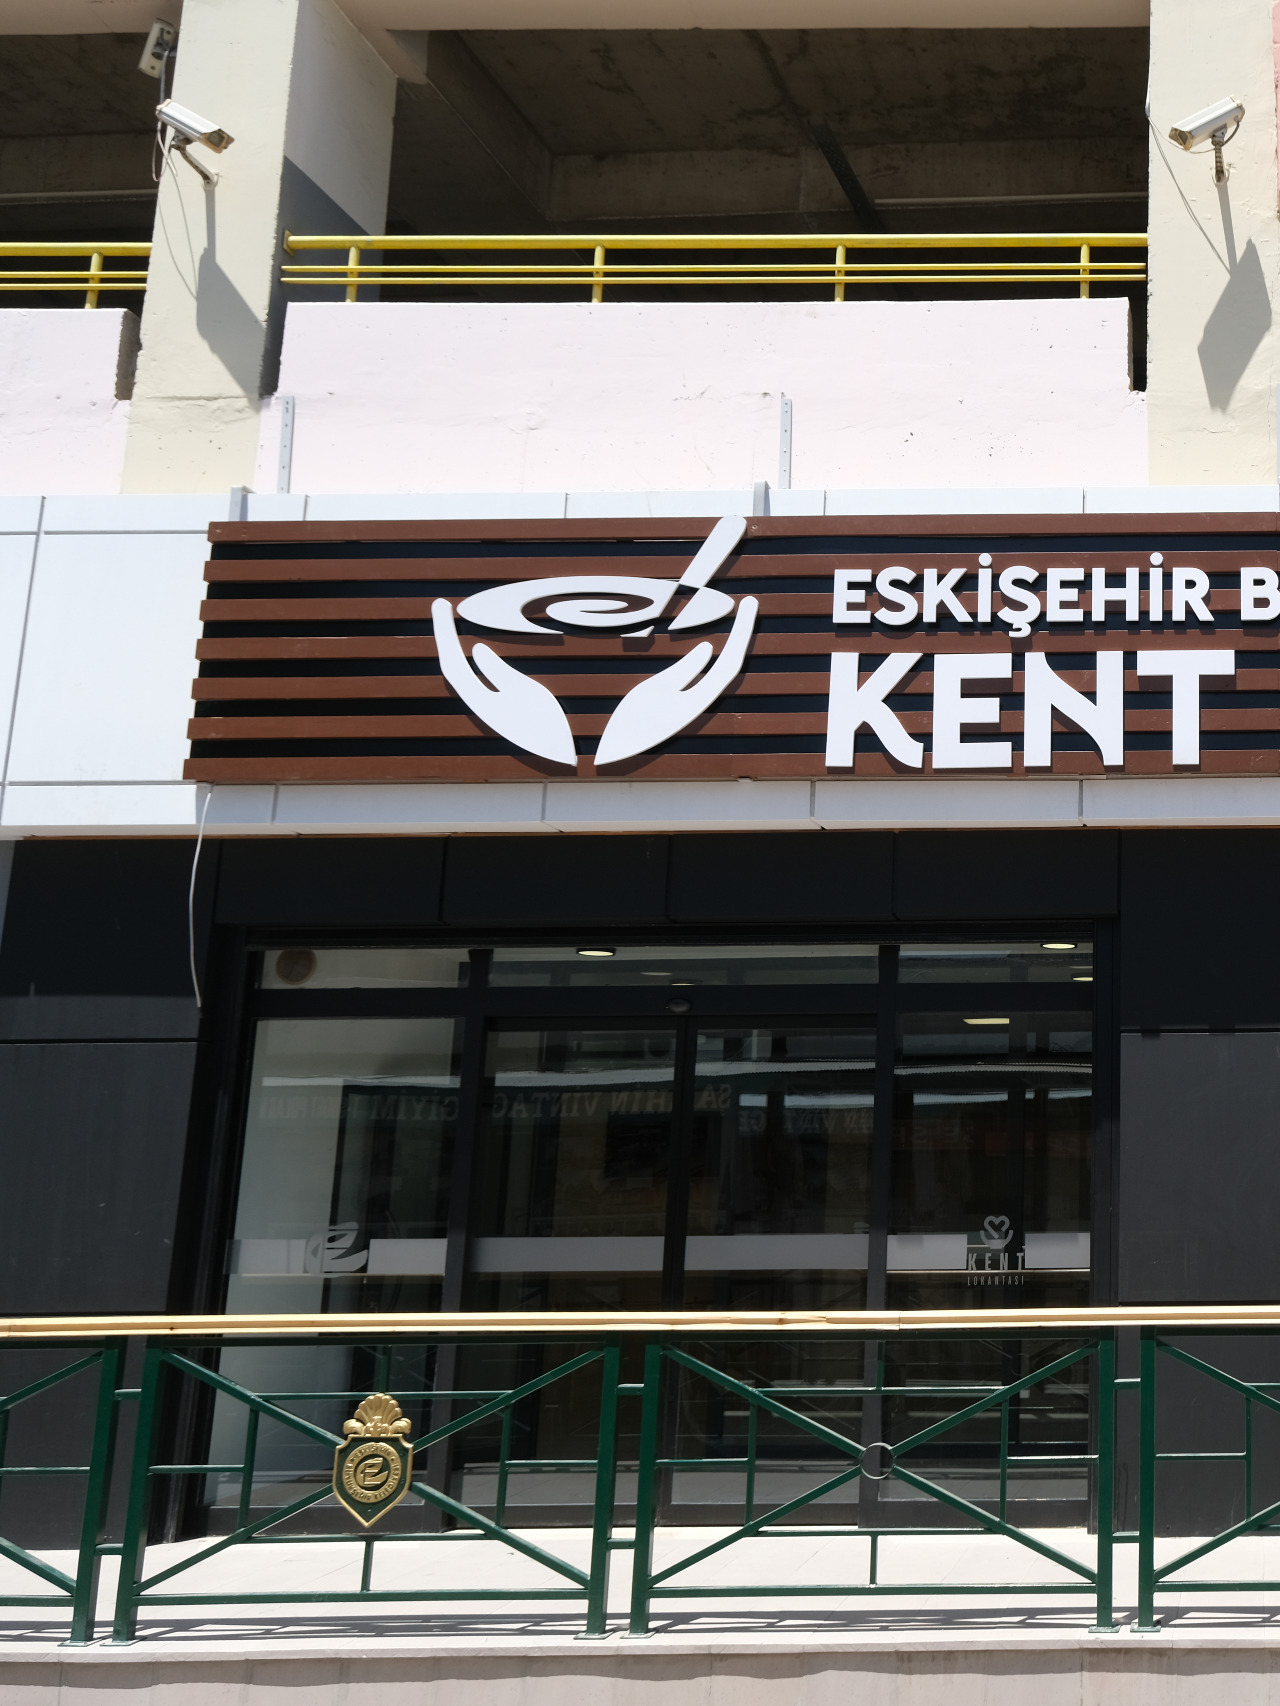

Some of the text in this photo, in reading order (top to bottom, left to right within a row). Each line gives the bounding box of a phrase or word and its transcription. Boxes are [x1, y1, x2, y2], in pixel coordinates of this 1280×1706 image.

[832, 551, 1215, 638] ESKİŞEHİR
[824, 649, 1236, 769] KENT
[967, 1275, 1024, 1286] LOKANTASI
[968, 1252, 1024, 1271] KENT
